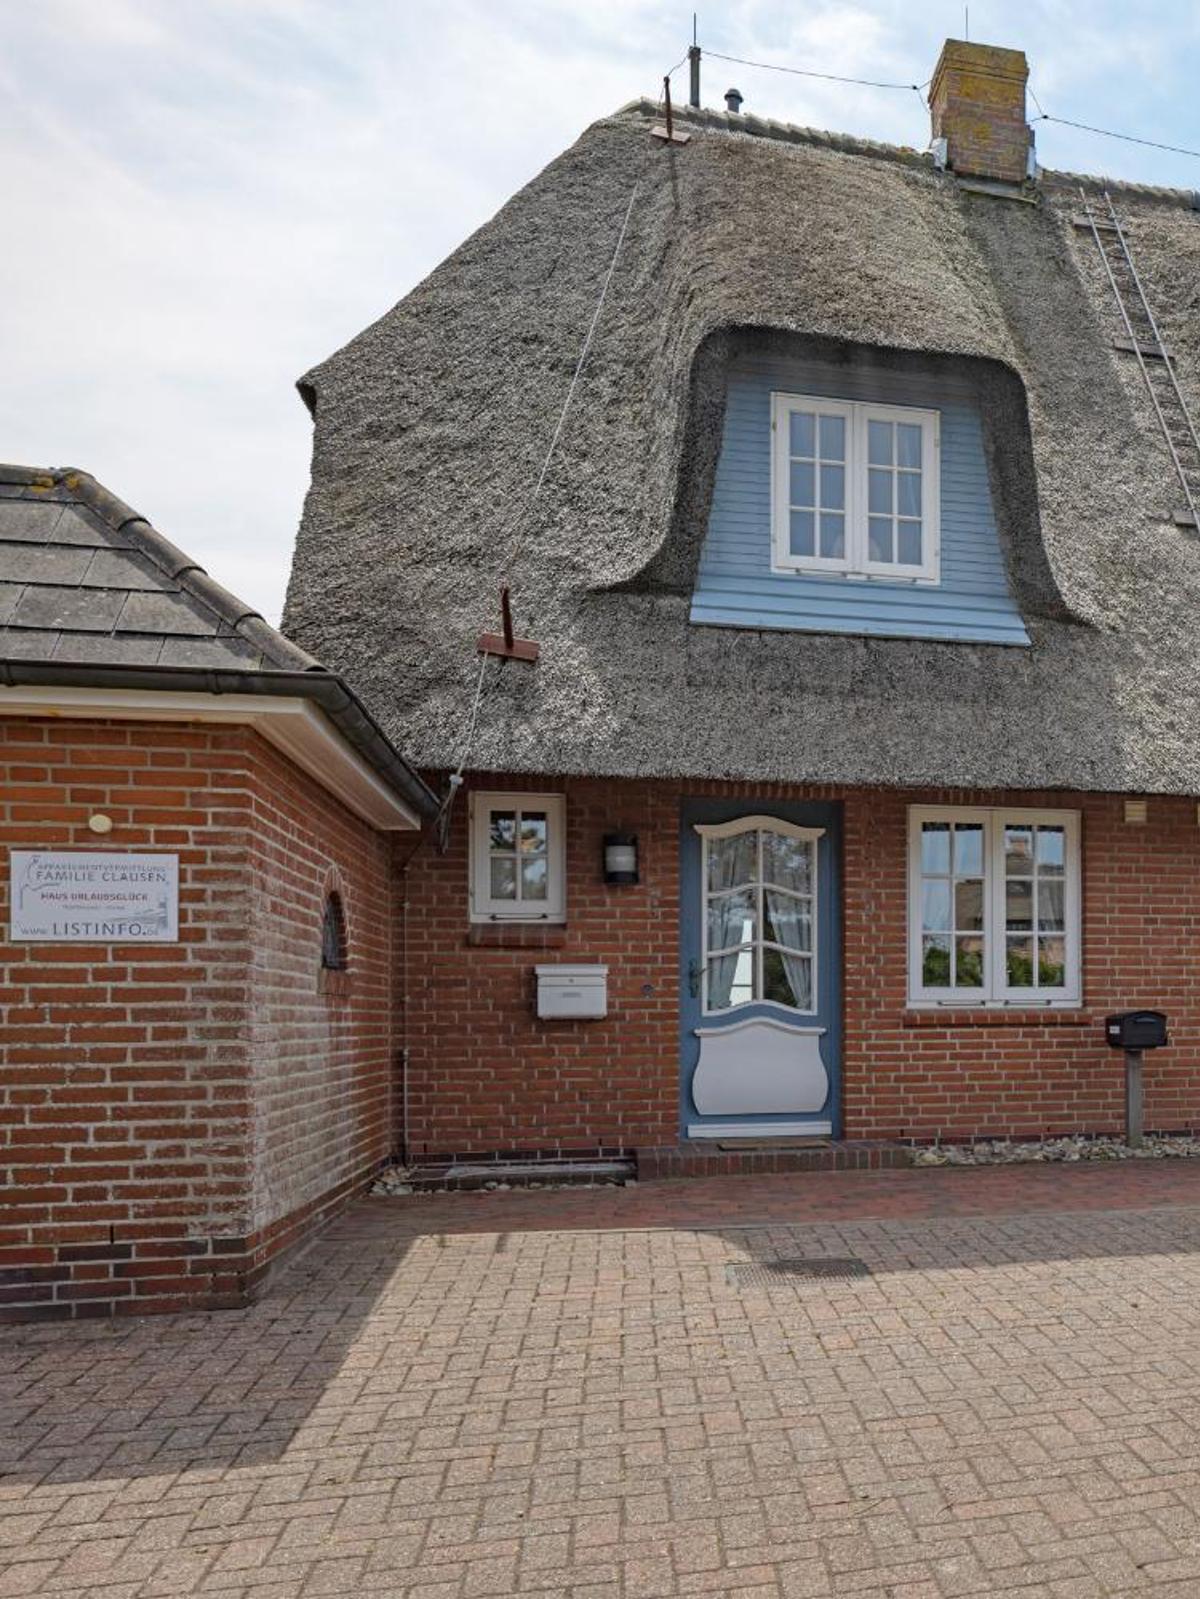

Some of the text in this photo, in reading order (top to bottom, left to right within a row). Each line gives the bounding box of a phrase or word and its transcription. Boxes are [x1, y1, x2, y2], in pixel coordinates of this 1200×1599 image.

[36, 871, 166, 881] FAMILIE CLAUSEN
[41, 892, 68, 900] HAUS
